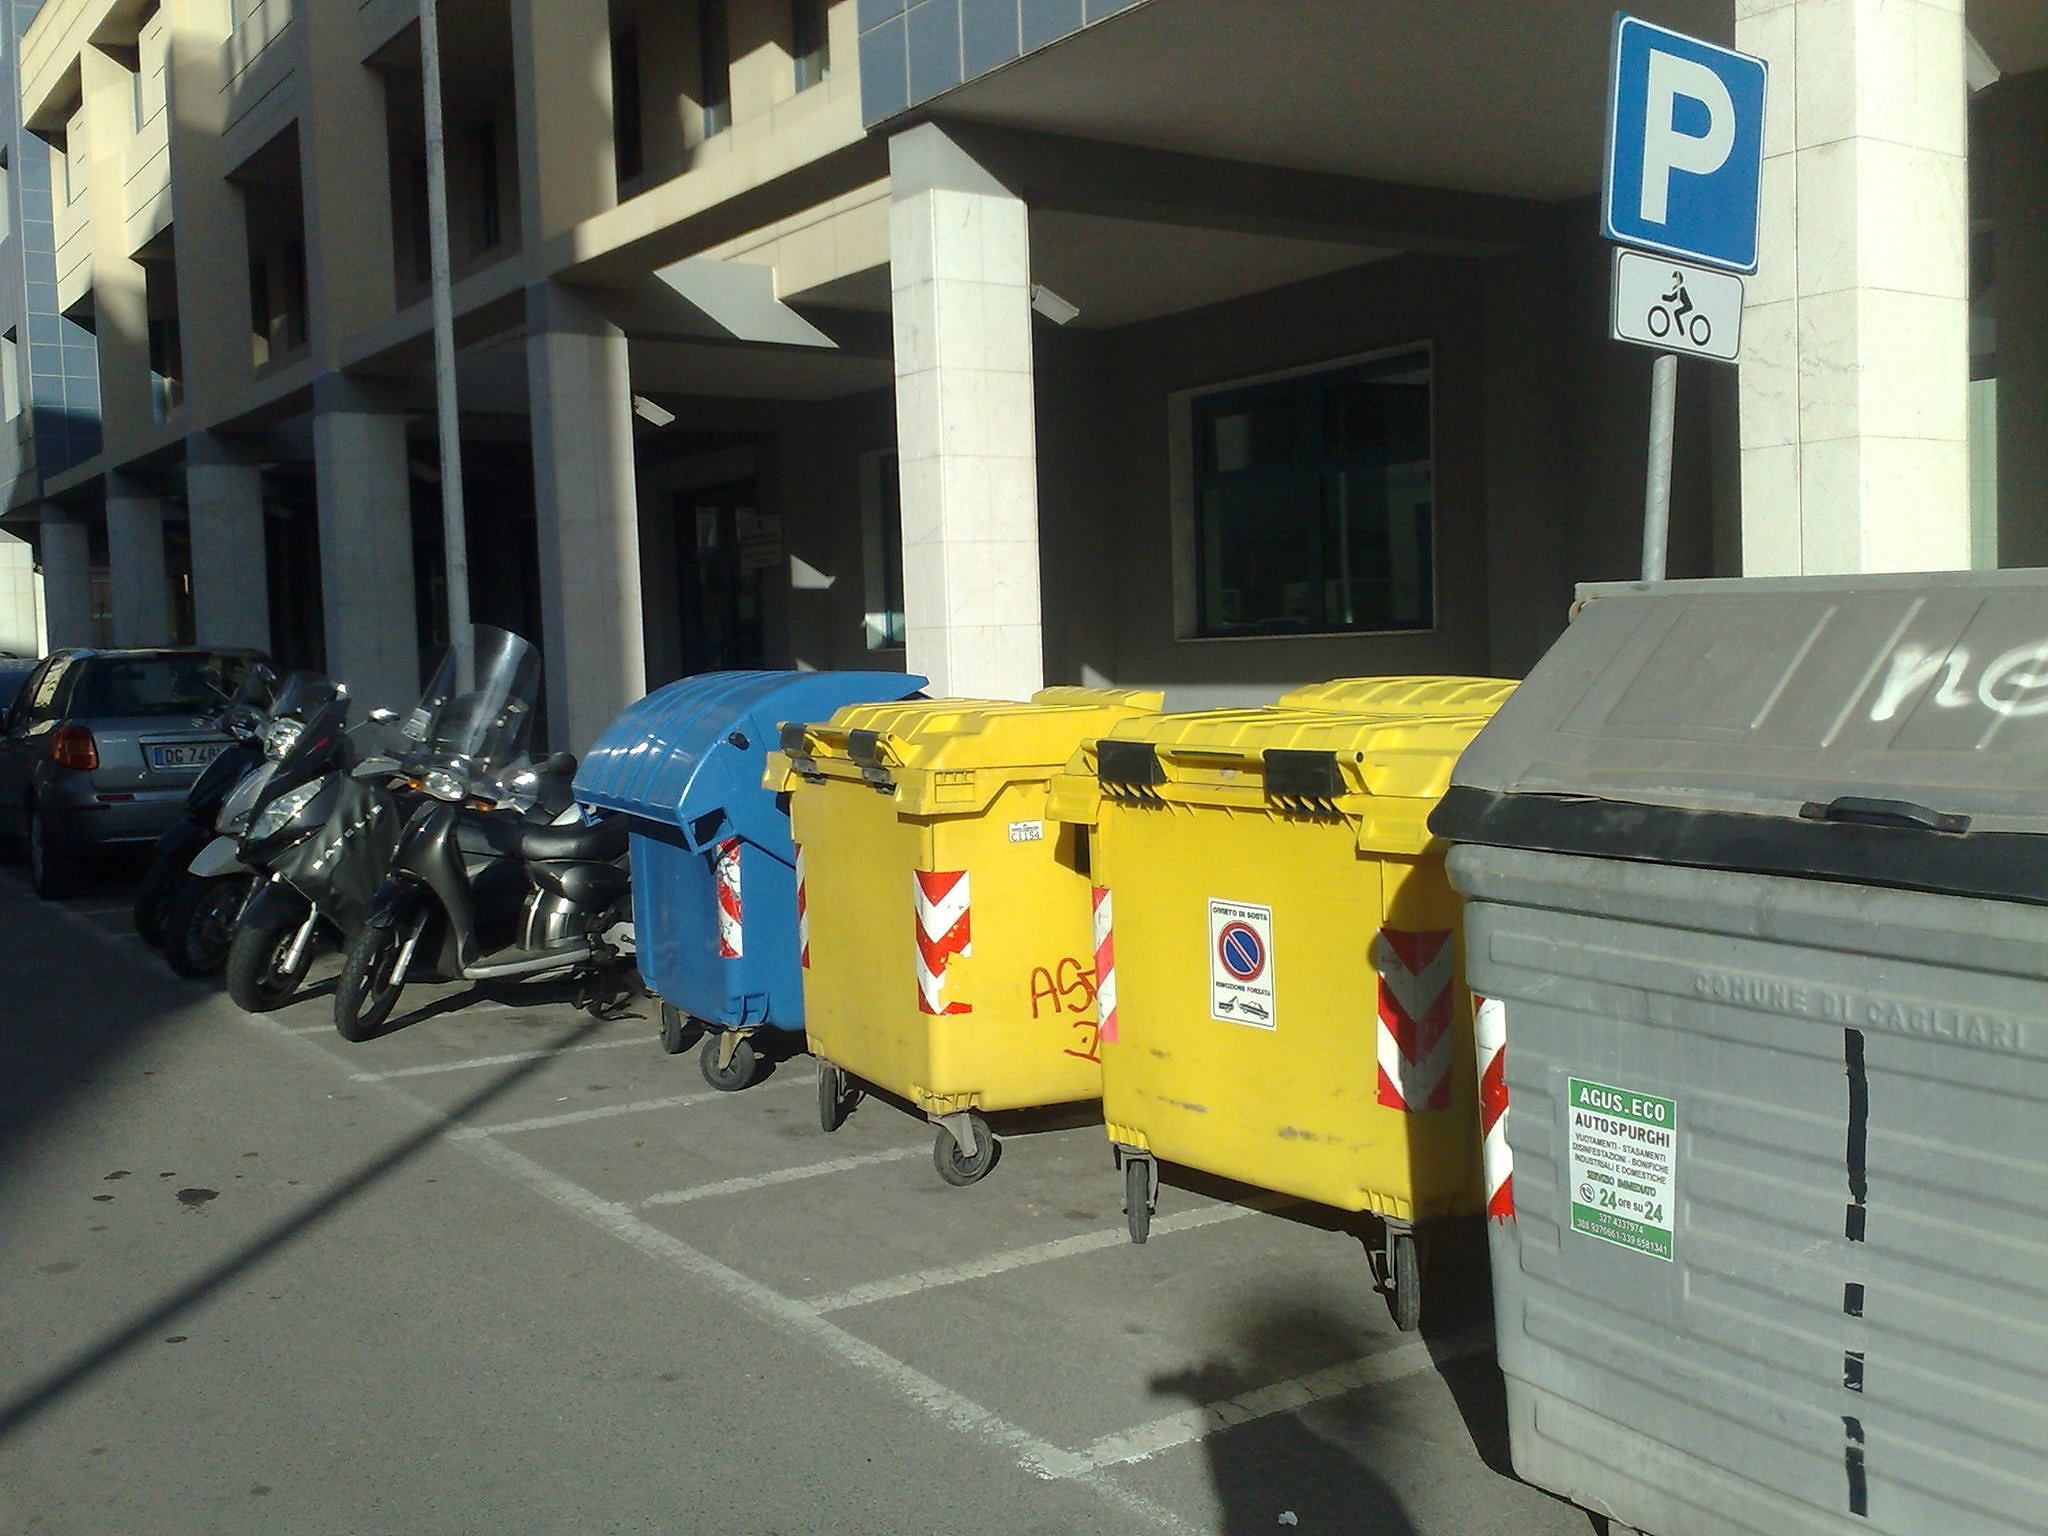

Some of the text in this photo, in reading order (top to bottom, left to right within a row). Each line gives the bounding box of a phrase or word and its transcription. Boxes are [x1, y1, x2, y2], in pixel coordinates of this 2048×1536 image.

[1640, 49, 1736, 224] P
[1238, 910, 1246, 918] DI
[1247, 911, 1268, 921] SOSTA
[1693, 973, 2025, 1050] COMUNE DI CAGLIARI
[1580, 1086, 1665, 1122] AGUS.ECO
[1575, 1112, 1670, 1148] AUTOSPURGHI
[1576, 1133, 1617, 1150] VUOTAMENTI
[1622, 1144, 1666, 1163] STASAMENTI
[1622, 1166, 1666, 1185] DOMESTICHE
[1632, 1158, 1669, 1175] BONIFICHE
[1600, 1187, 1663, 1224] 24 ore su 24
